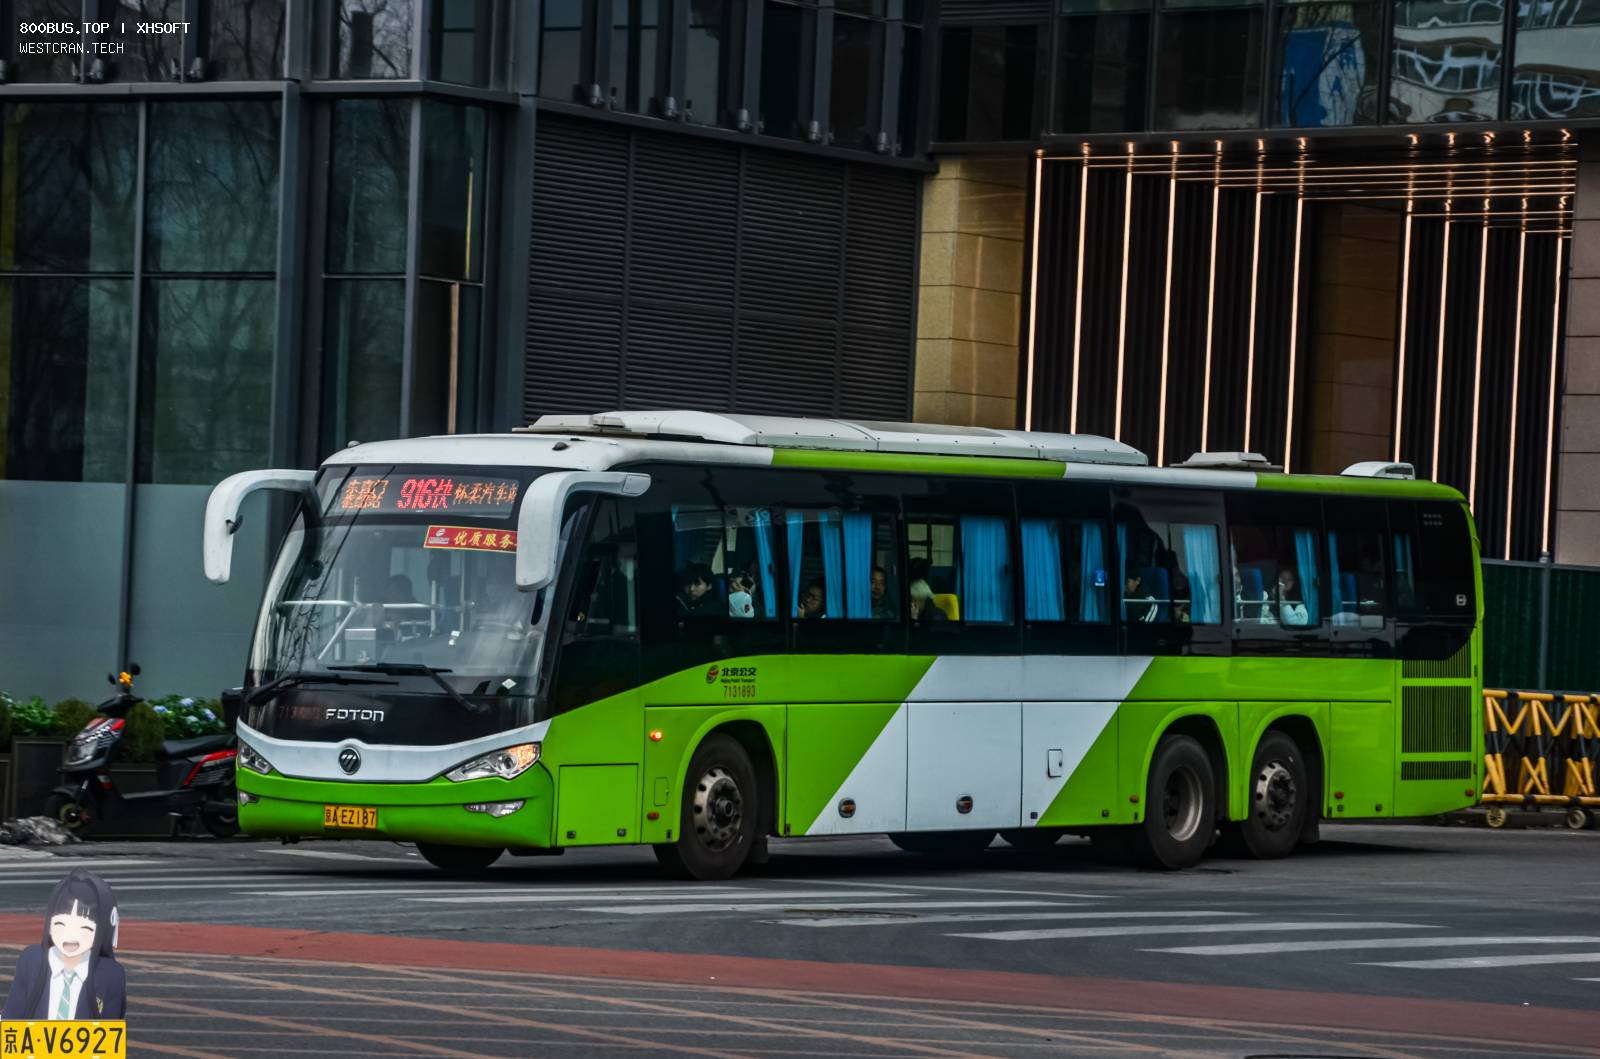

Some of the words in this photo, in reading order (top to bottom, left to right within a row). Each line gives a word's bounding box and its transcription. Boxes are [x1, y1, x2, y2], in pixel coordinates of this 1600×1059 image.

[453, 531, 513, 548] 优质服务
[721, 667, 757, 677] 北京公交
[325, 708, 385, 722] FOTON
